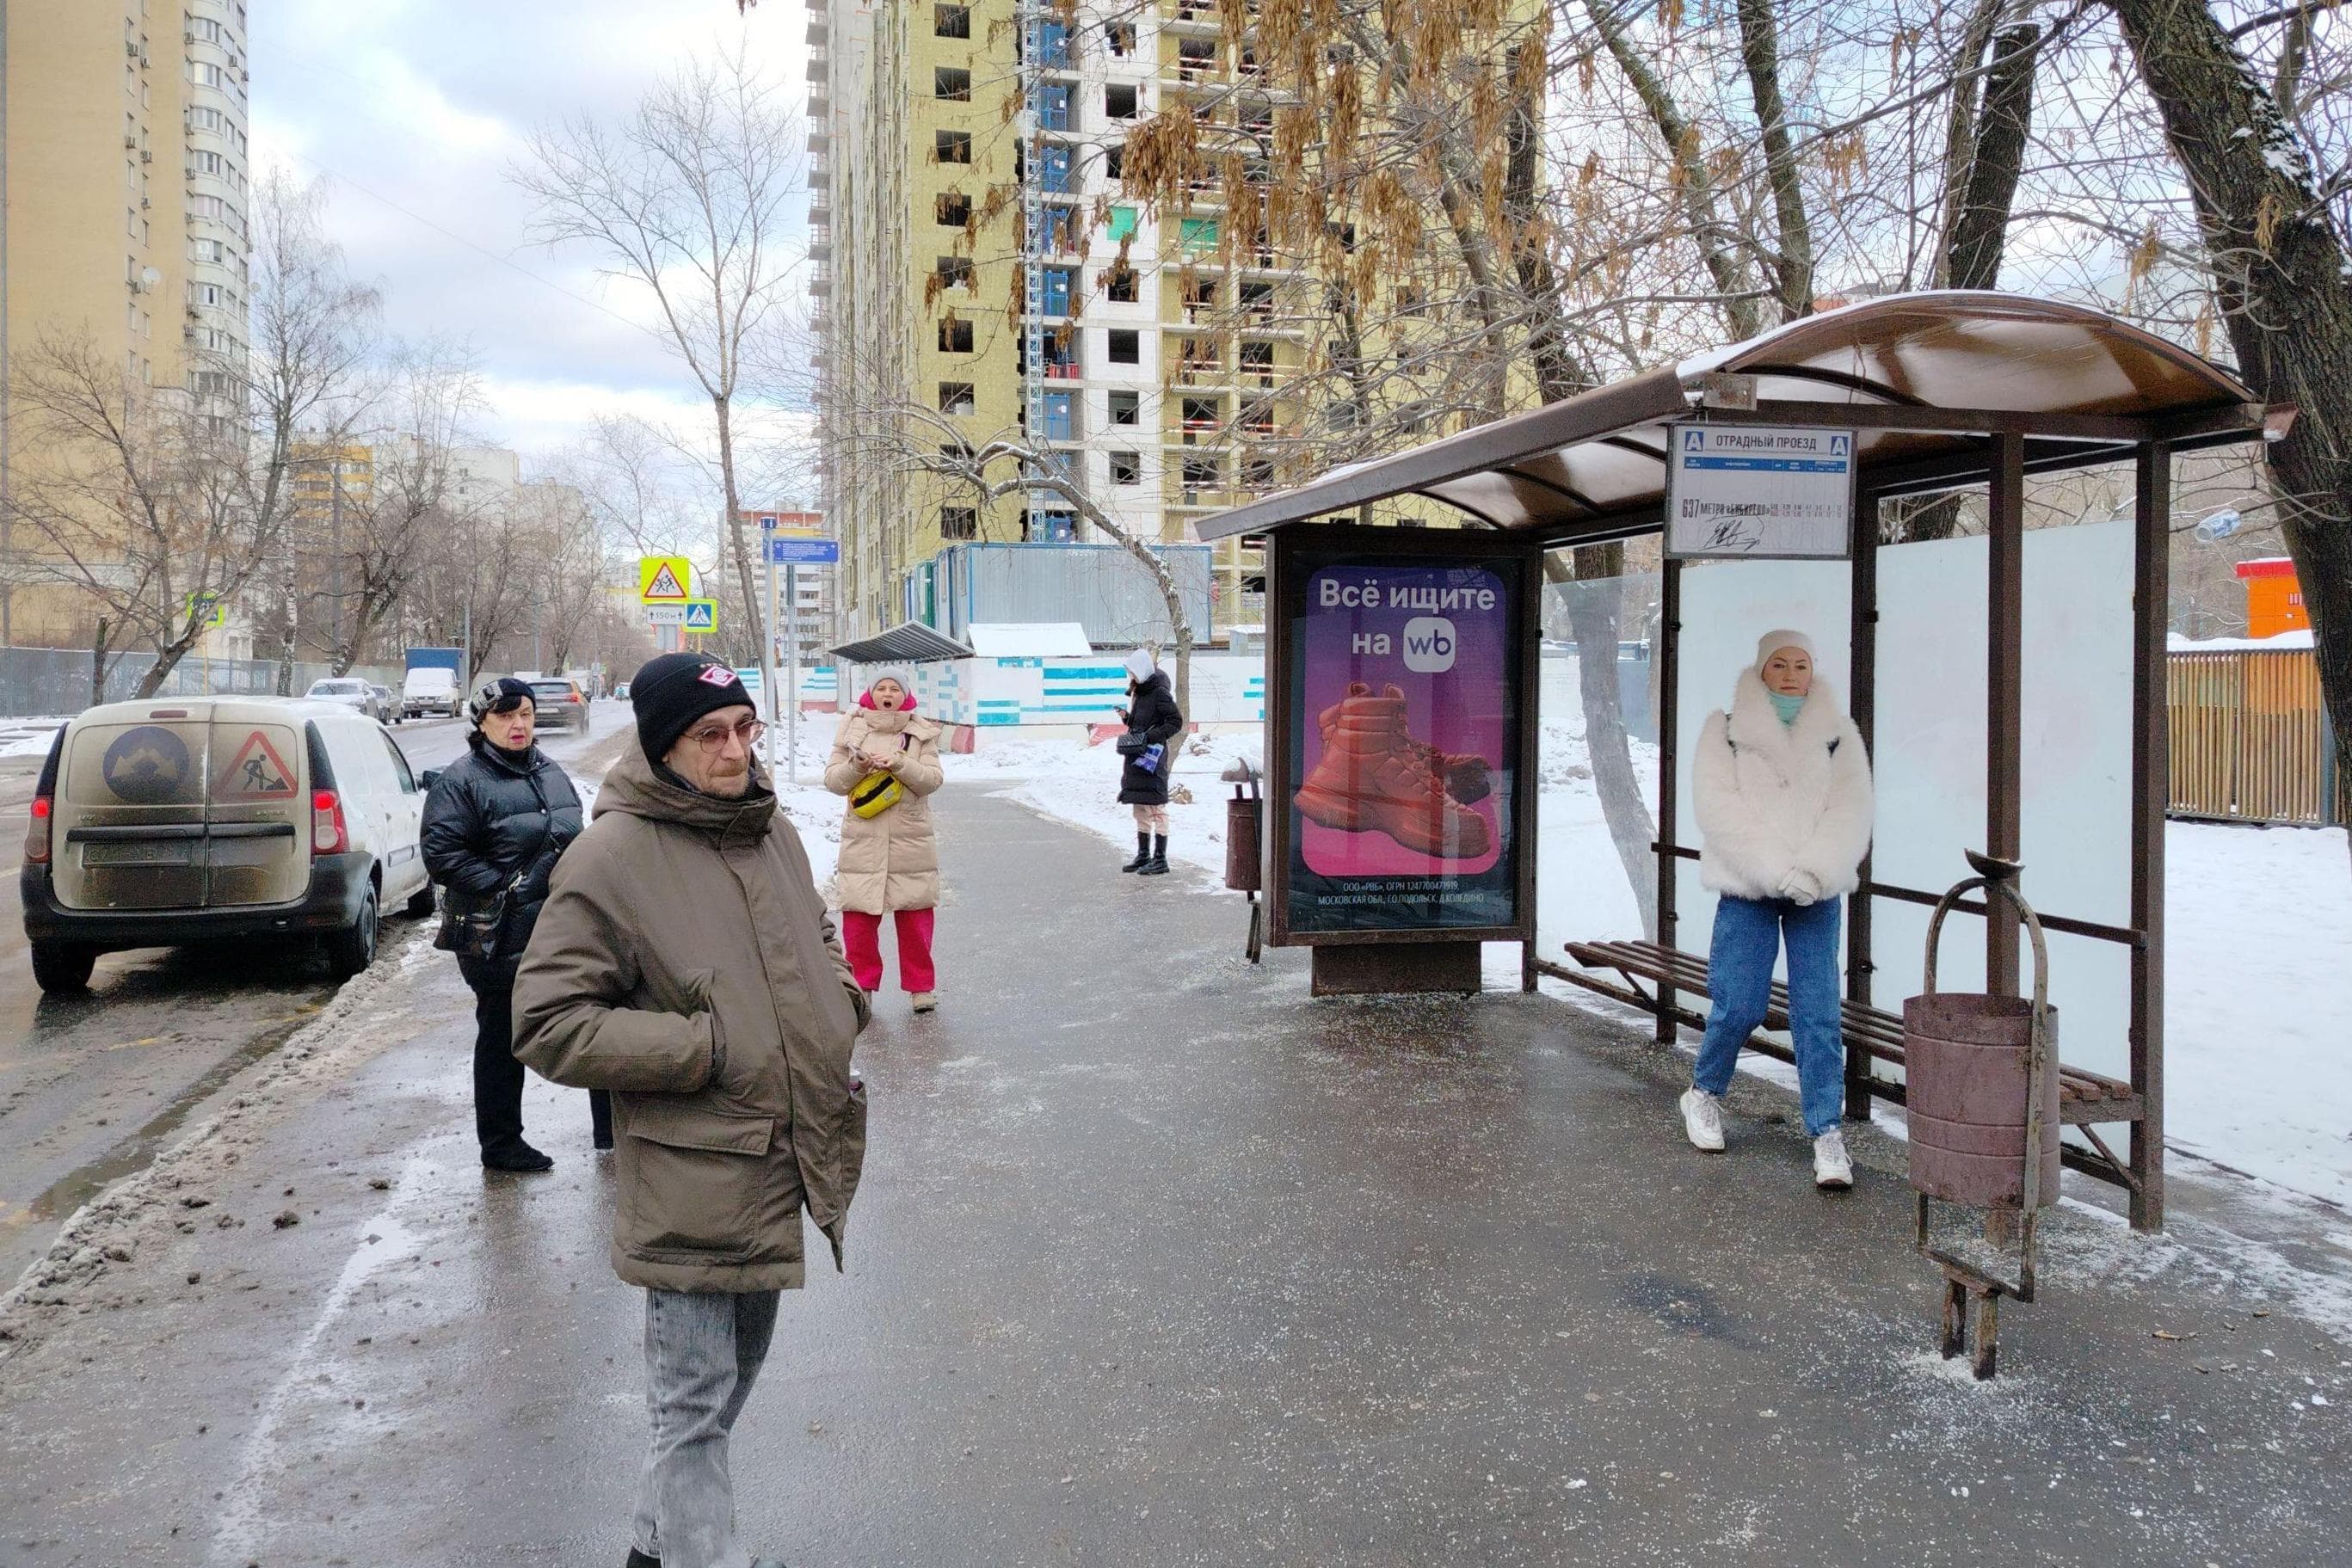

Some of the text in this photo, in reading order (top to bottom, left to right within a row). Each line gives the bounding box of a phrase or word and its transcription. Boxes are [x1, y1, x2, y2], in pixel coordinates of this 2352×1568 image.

[1715, 434, 1774, 449] ОТРАДНЫЙ
[1776, 437, 1817, 452] ПРОЕЗД
[1682, 498, 1700, 519] 637
[1700, 502, 1725, 516] МЕТРО
[1319, 578, 1495, 615] Всё ищите
[1352, 630, 1452, 656] на wb
[1343, 882, 1360, 892] ООО
[1386, 881, 1406, 892] ОГРН
[1317, 895, 1366, 906] МОСКОВСКАЯ
